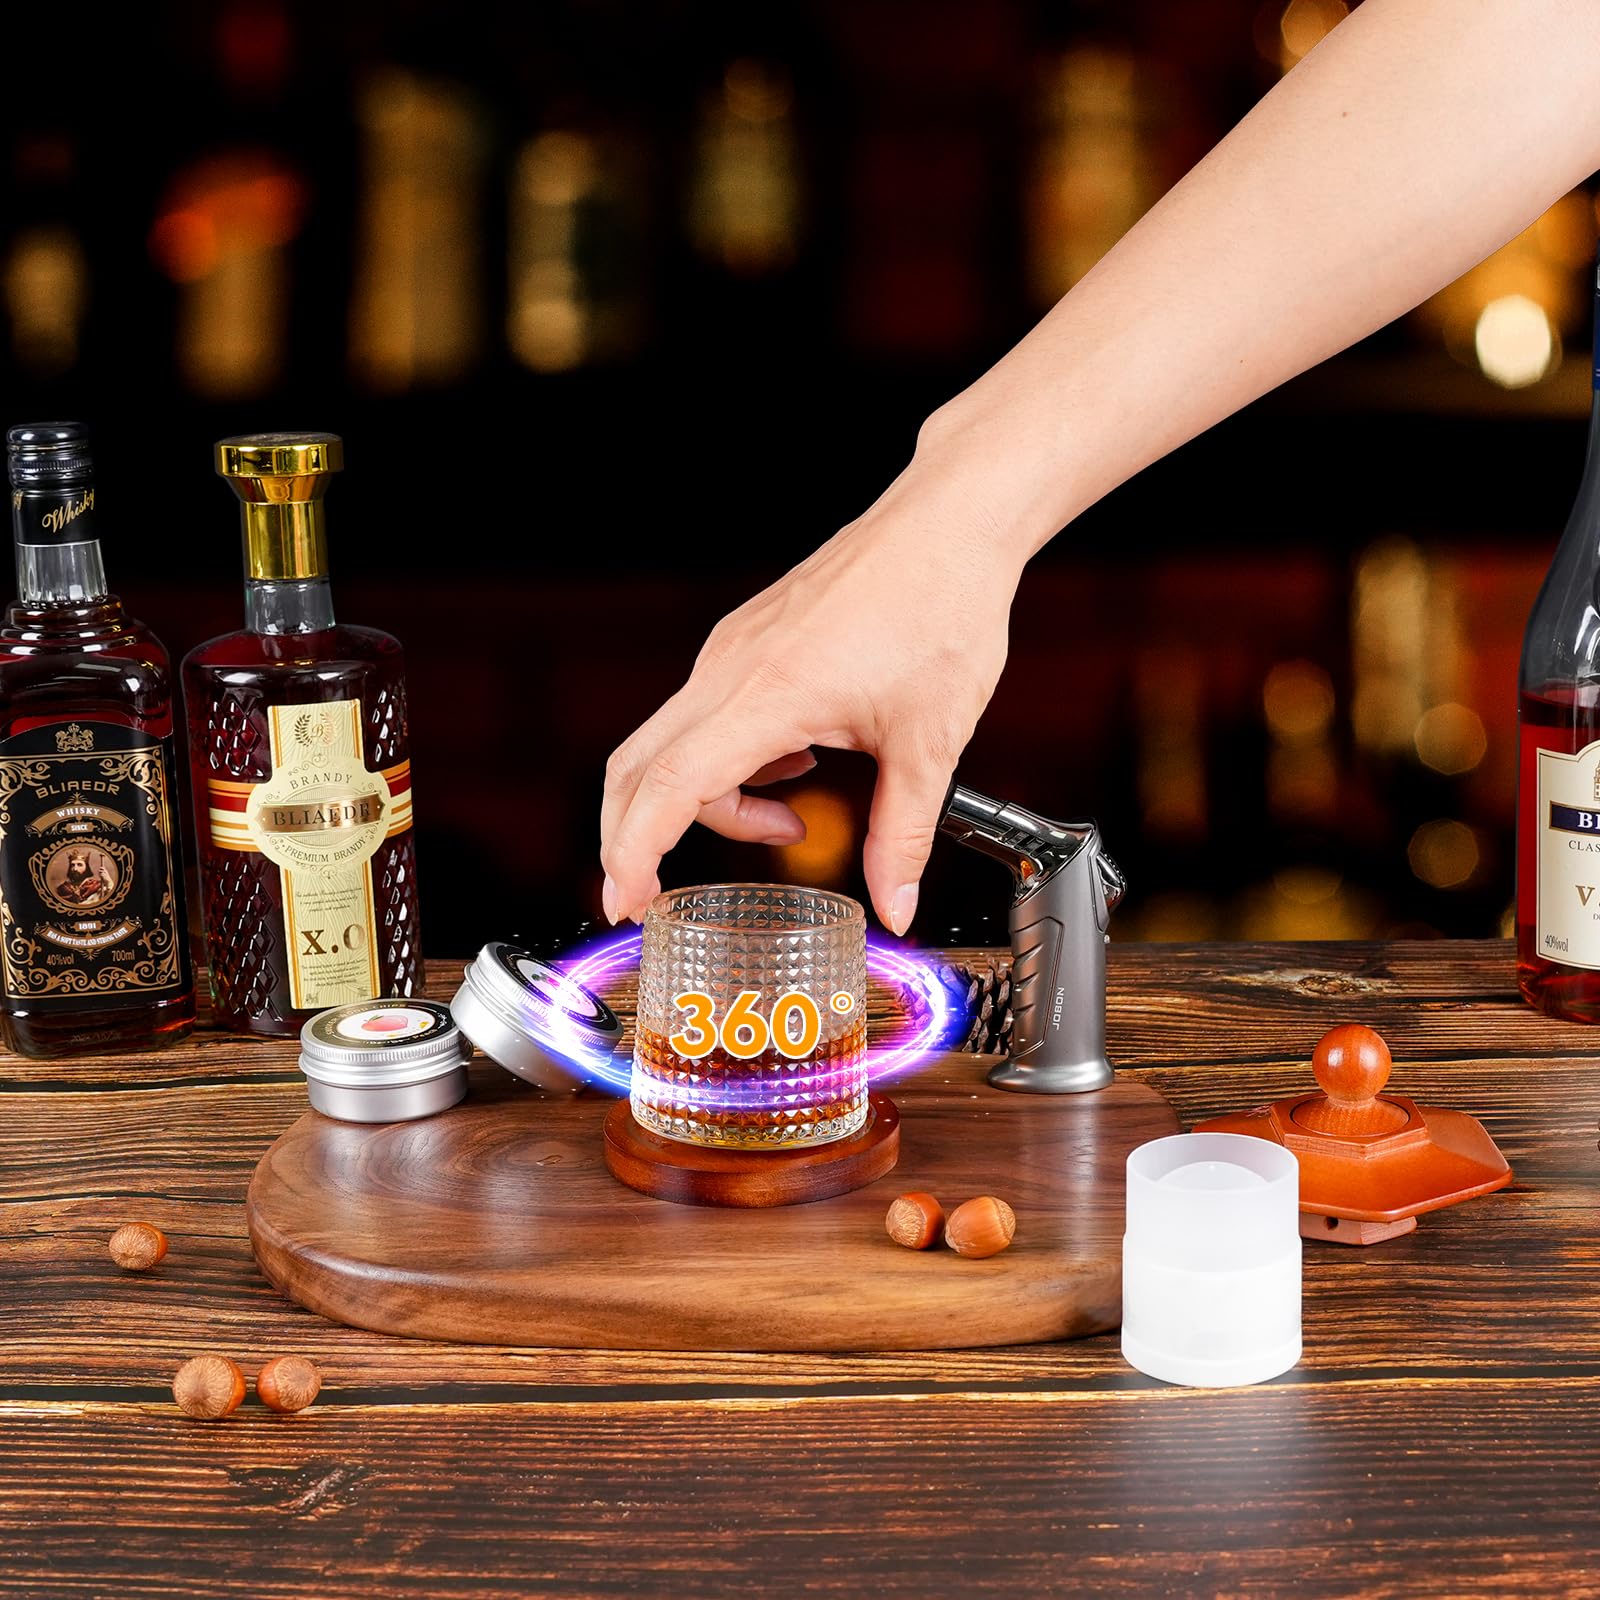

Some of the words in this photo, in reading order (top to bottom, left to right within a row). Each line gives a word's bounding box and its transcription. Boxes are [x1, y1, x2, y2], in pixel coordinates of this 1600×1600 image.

[41, 488, 95, 533] Whisky
[35, 780, 120, 799] BLIAEDR
[289, 772, 353, 790] BRANDY
[56, 807, 100, 818] WHISKY
[273, 803, 370, 826] BLIAEDR
[284, 845, 329, 863] PREMIUM
[333, 836, 366, 861] BRANDY
[301, 923, 366, 956] X.O
[111, 949, 136, 961] 700ml
